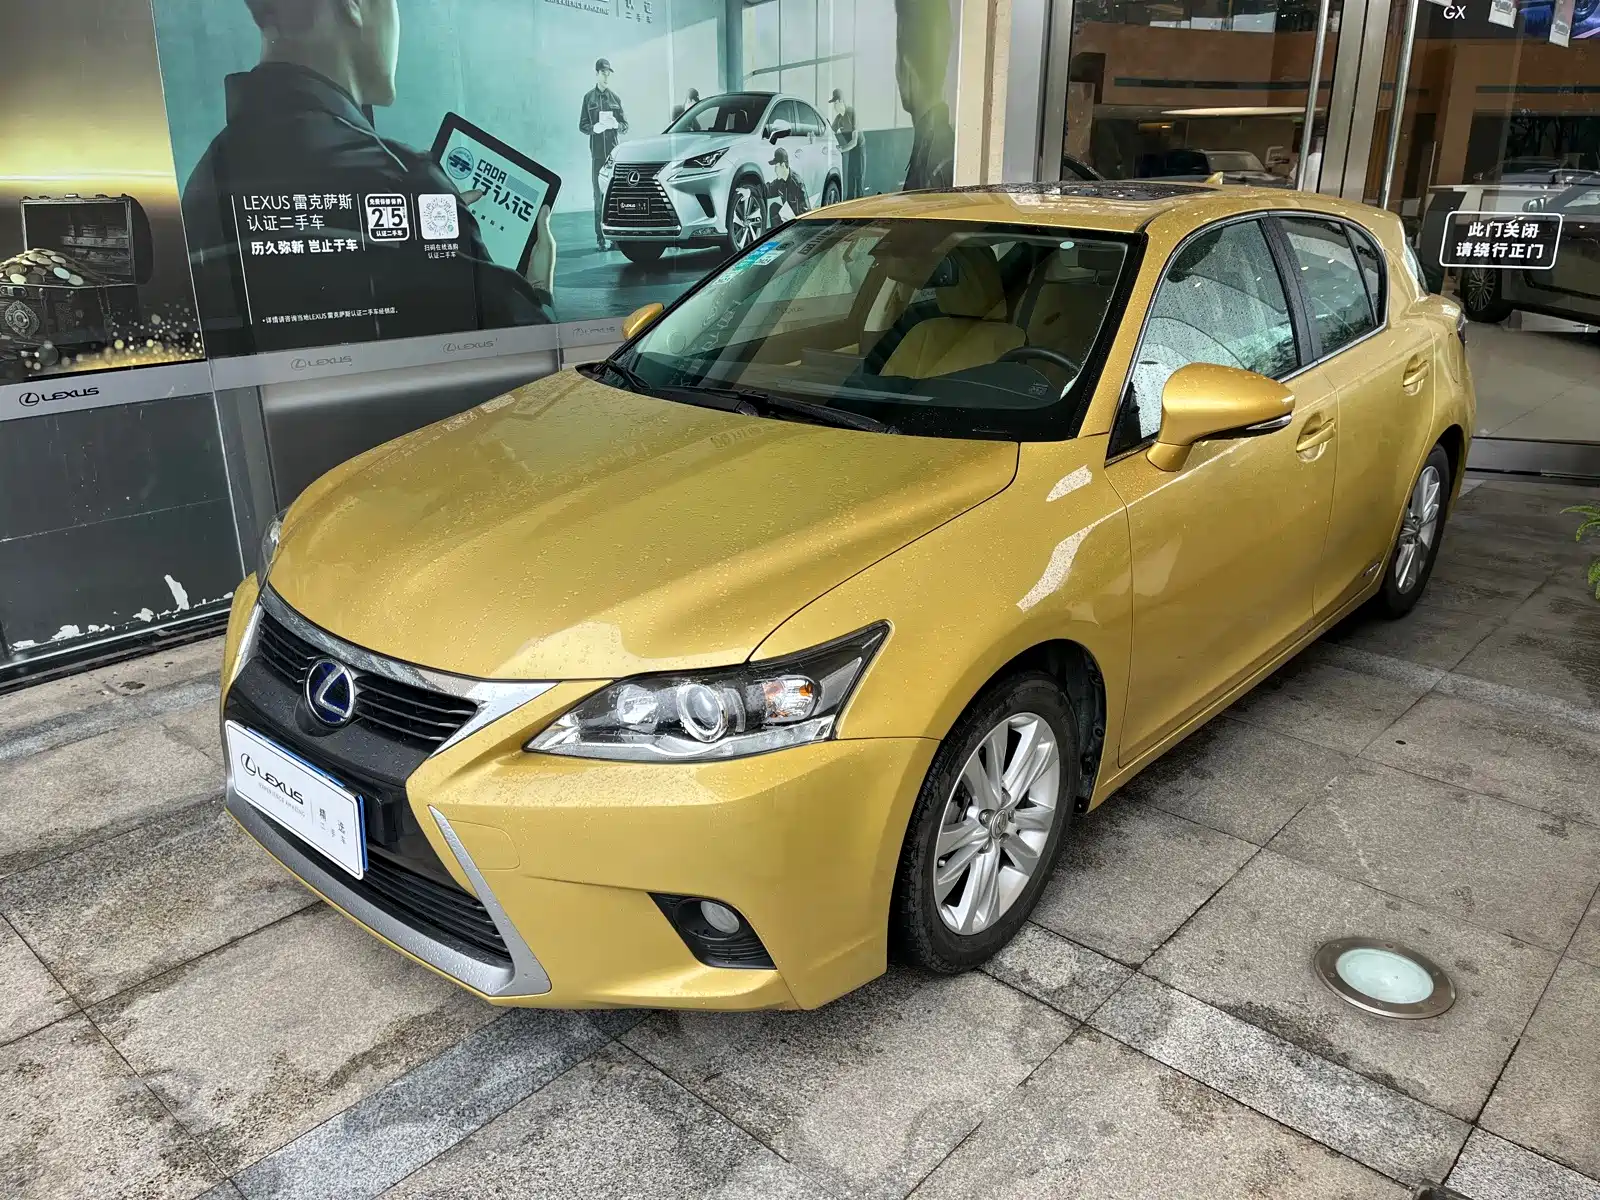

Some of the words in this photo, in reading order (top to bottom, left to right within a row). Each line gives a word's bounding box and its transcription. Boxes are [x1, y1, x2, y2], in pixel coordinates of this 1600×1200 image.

[1443, 5, 1467, 20] GX
[476, 159, 507, 184] CADA
[243, 195, 291, 210] LEXUS
[293, 193, 352, 210] 雷克萨斯
[247, 214, 325, 231] 认证二手车
[1468, 221, 1539, 239] 此门关闭
[376, 229, 403, 237] 认证二手车
[251, 240, 304, 255] 历久弥新
[308, 238, 358, 253] 岂止于车
[1456, 242, 1544, 259] 请绕行正门
[457, 340, 494, 351] LEXUS
[308, 355, 352, 367] LEXUS
[41, 387, 100, 402] LEXUS
[257, 766, 304, 805] LEXUS
